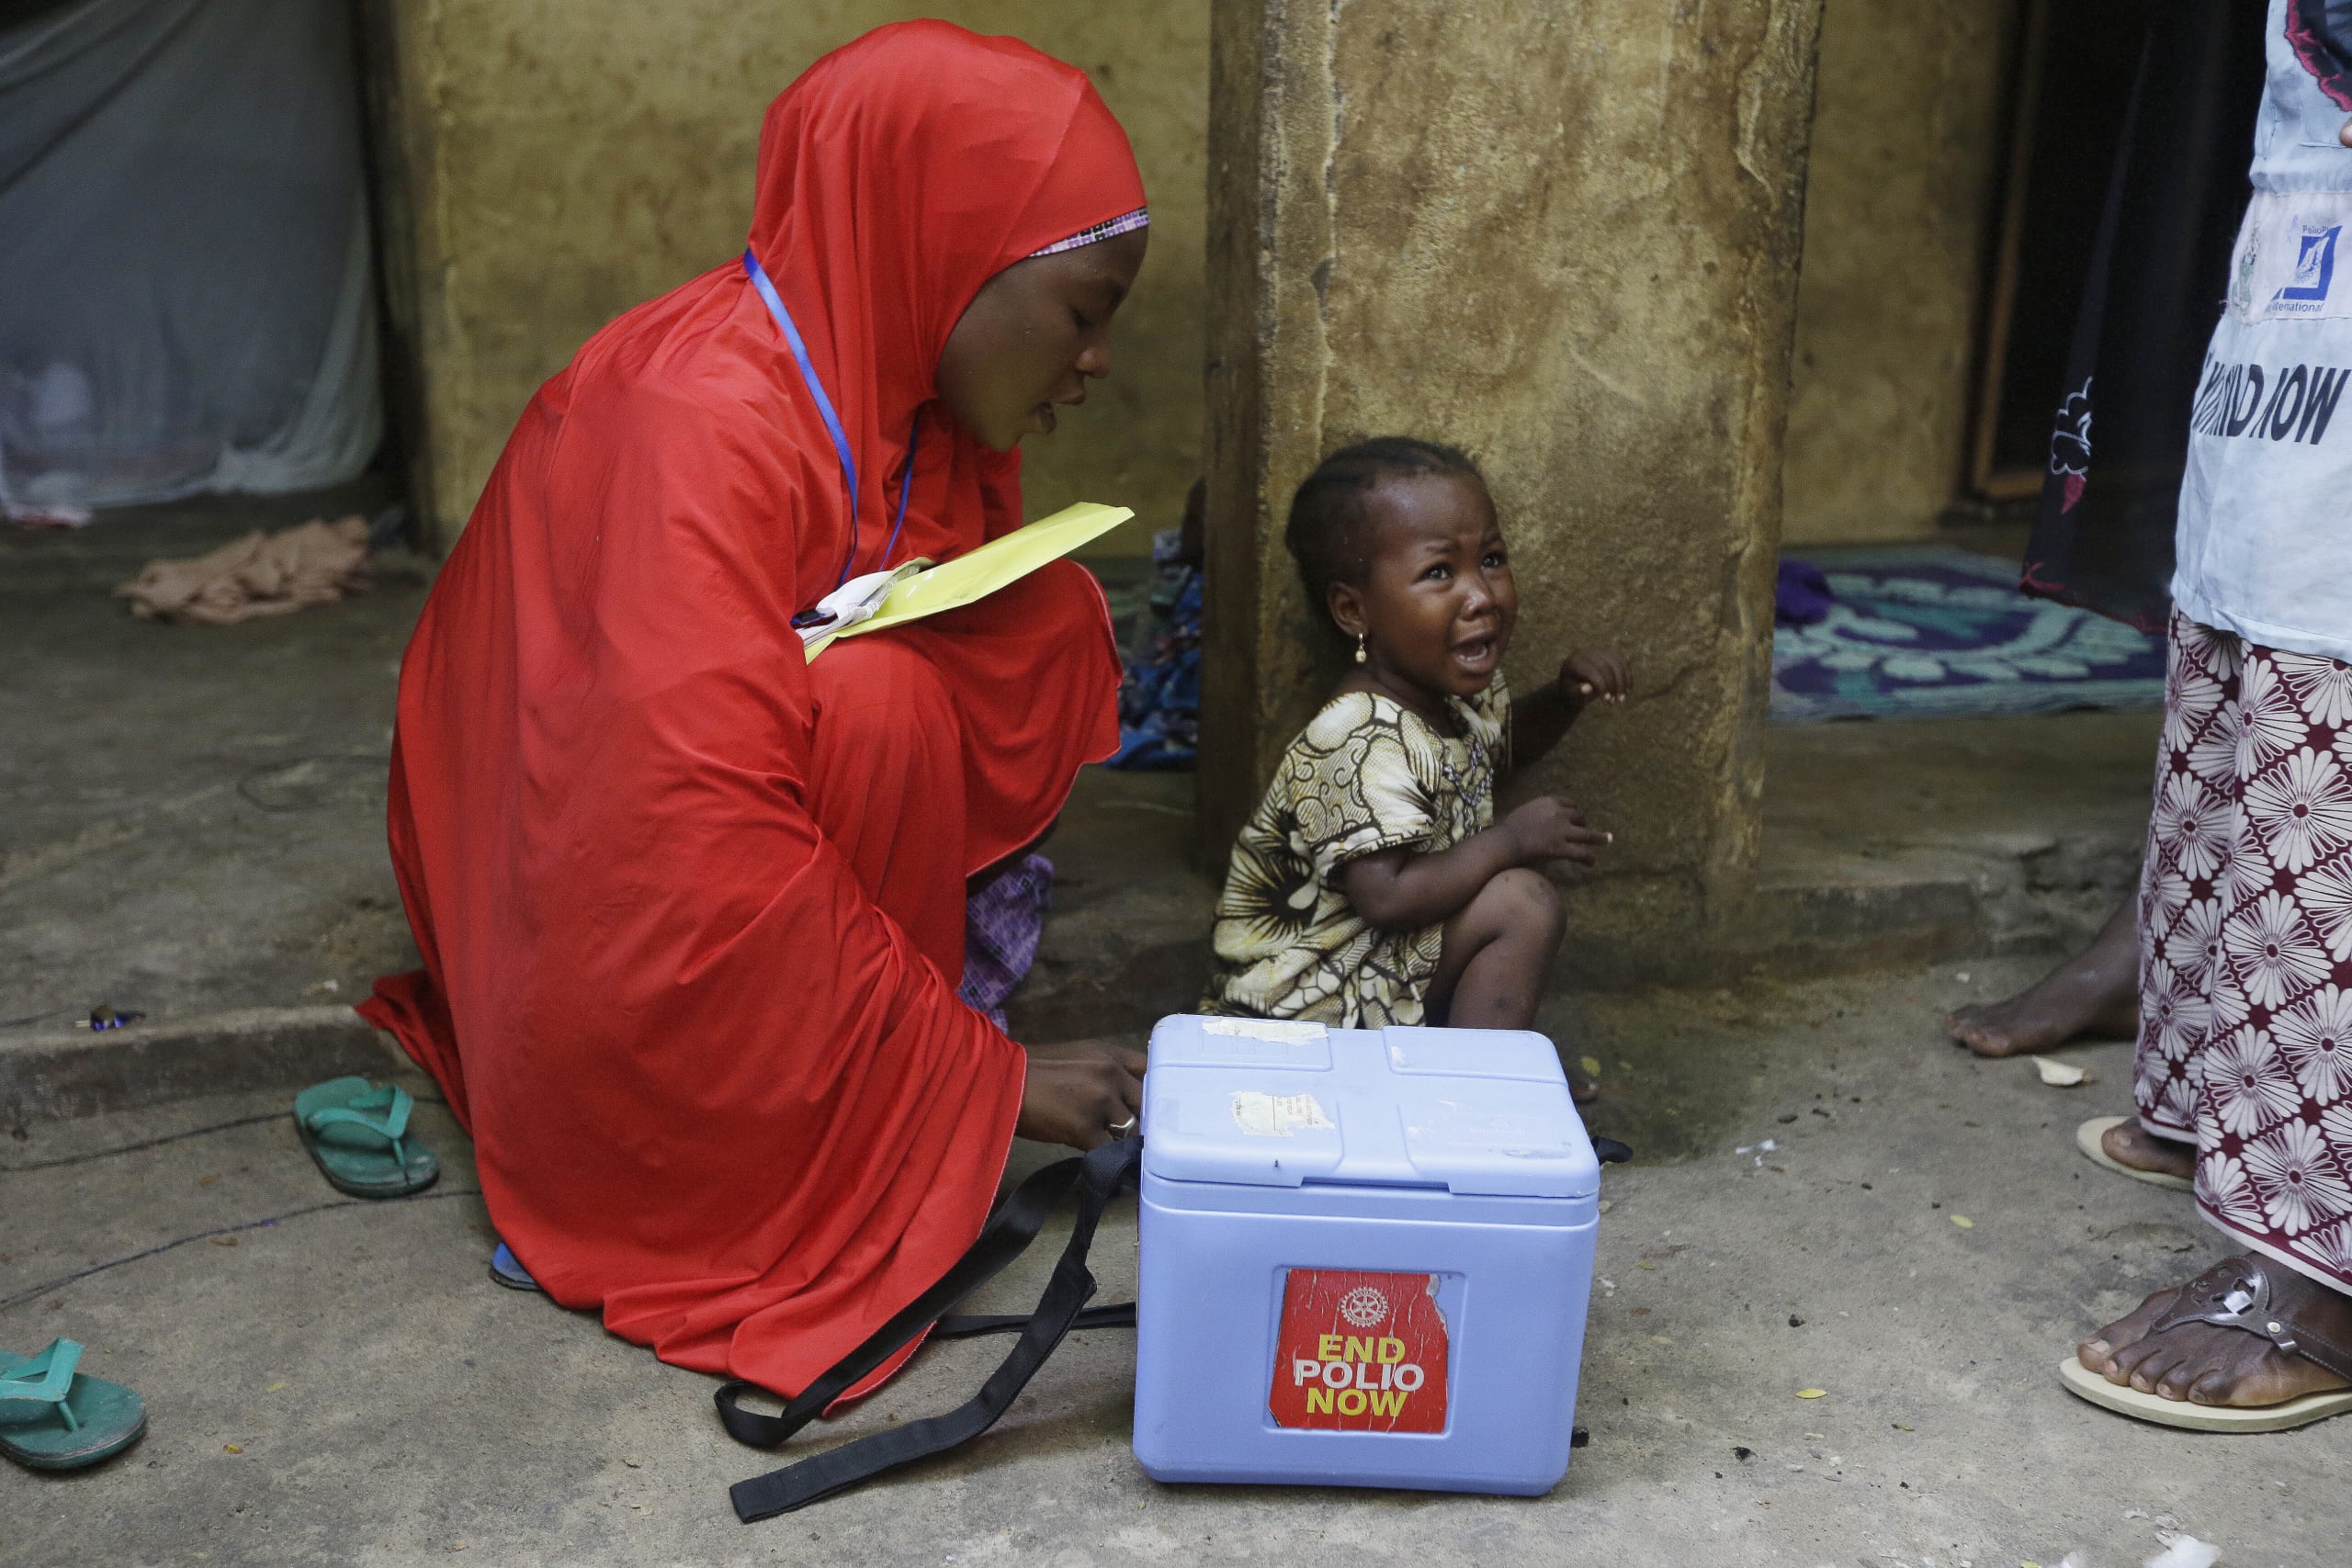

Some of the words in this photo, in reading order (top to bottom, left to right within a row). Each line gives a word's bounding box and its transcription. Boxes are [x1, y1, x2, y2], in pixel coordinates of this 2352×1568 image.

[1318, 1335, 1406, 1364] END
[1295, 1359, 1424, 1391] POLIO
[1306, 1387, 1408, 1416] NOW
